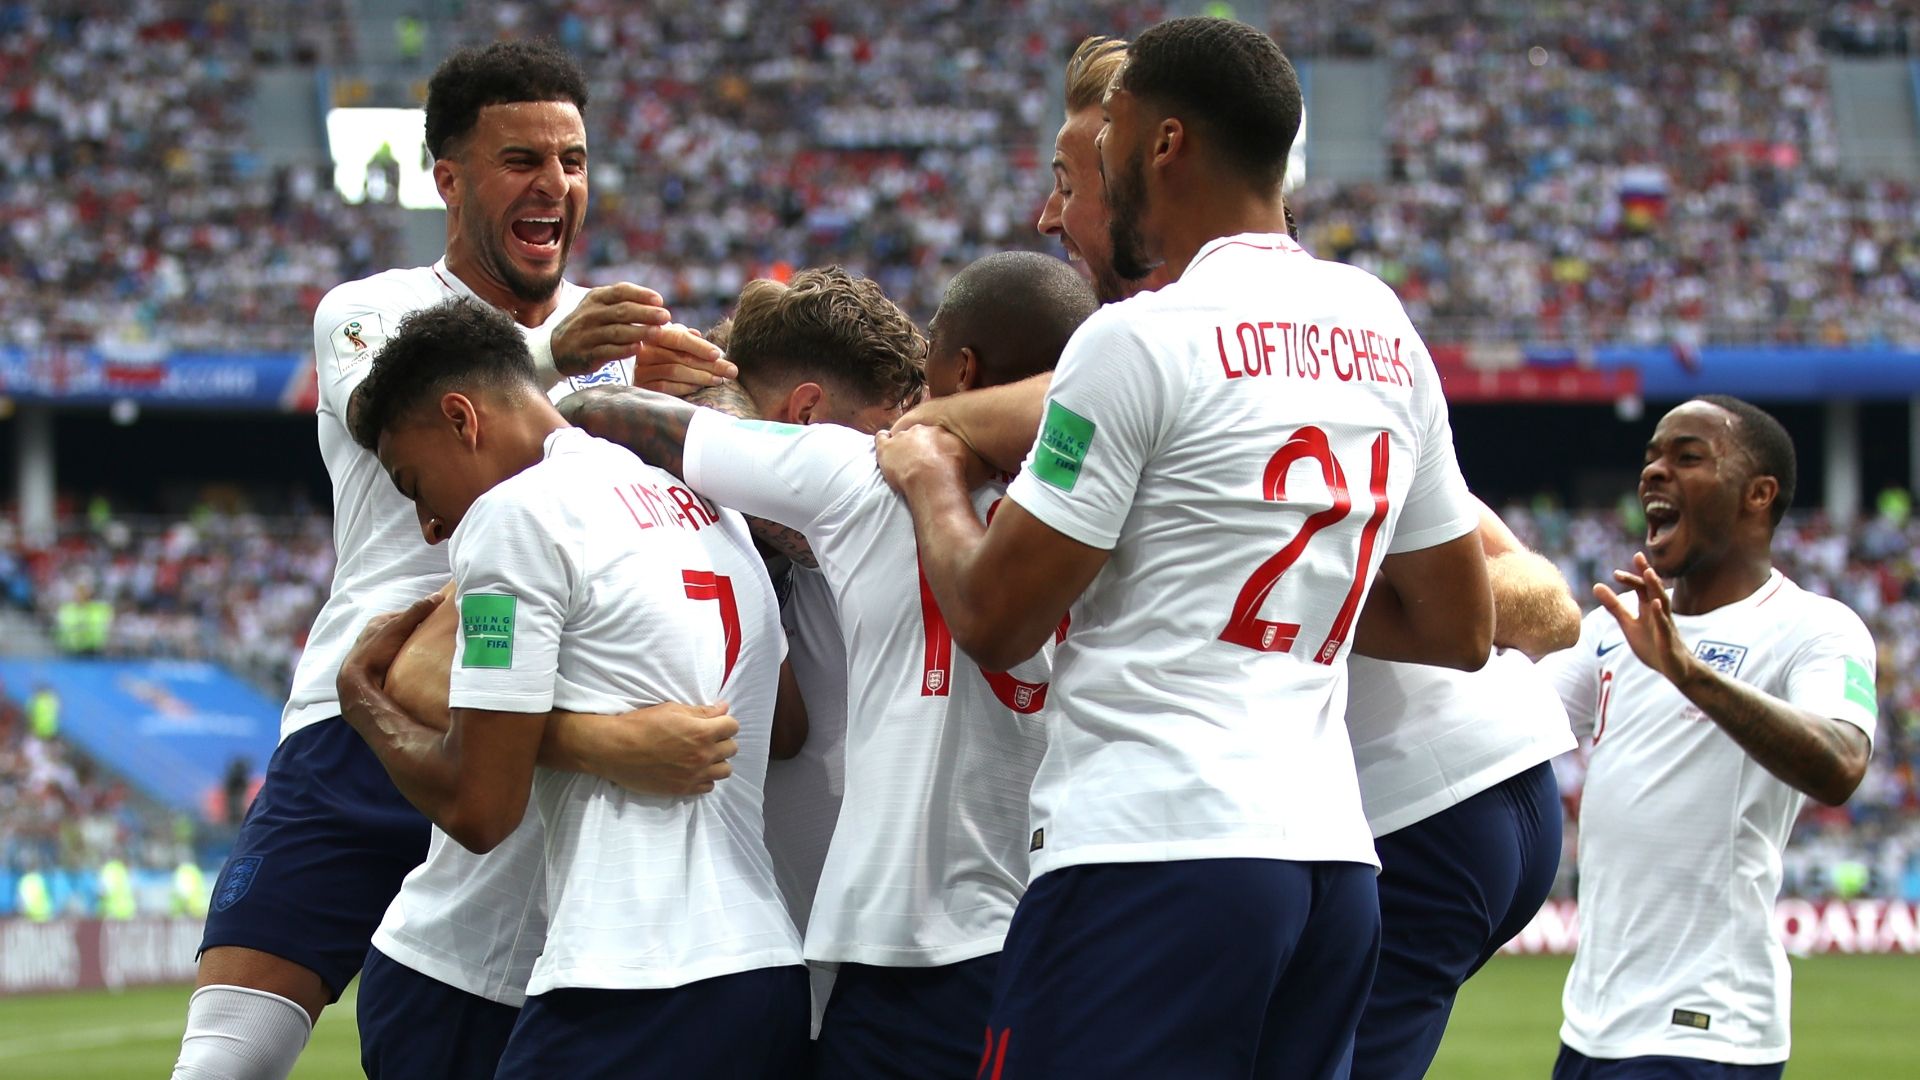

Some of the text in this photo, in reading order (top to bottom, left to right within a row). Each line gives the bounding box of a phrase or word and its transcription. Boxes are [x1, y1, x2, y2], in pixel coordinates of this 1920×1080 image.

[1215, 321, 1414, 387] LOFTUS-CHEEK
[1055, 457, 1076, 473] FIFA
[613, 483, 720, 531] LINRD
[1217, 425, 1390, 666] 21
[487, 640, 508, 648] FIFA
[681, 569, 742, 697] 7
[1773, 898, 1920, 957] QATA
